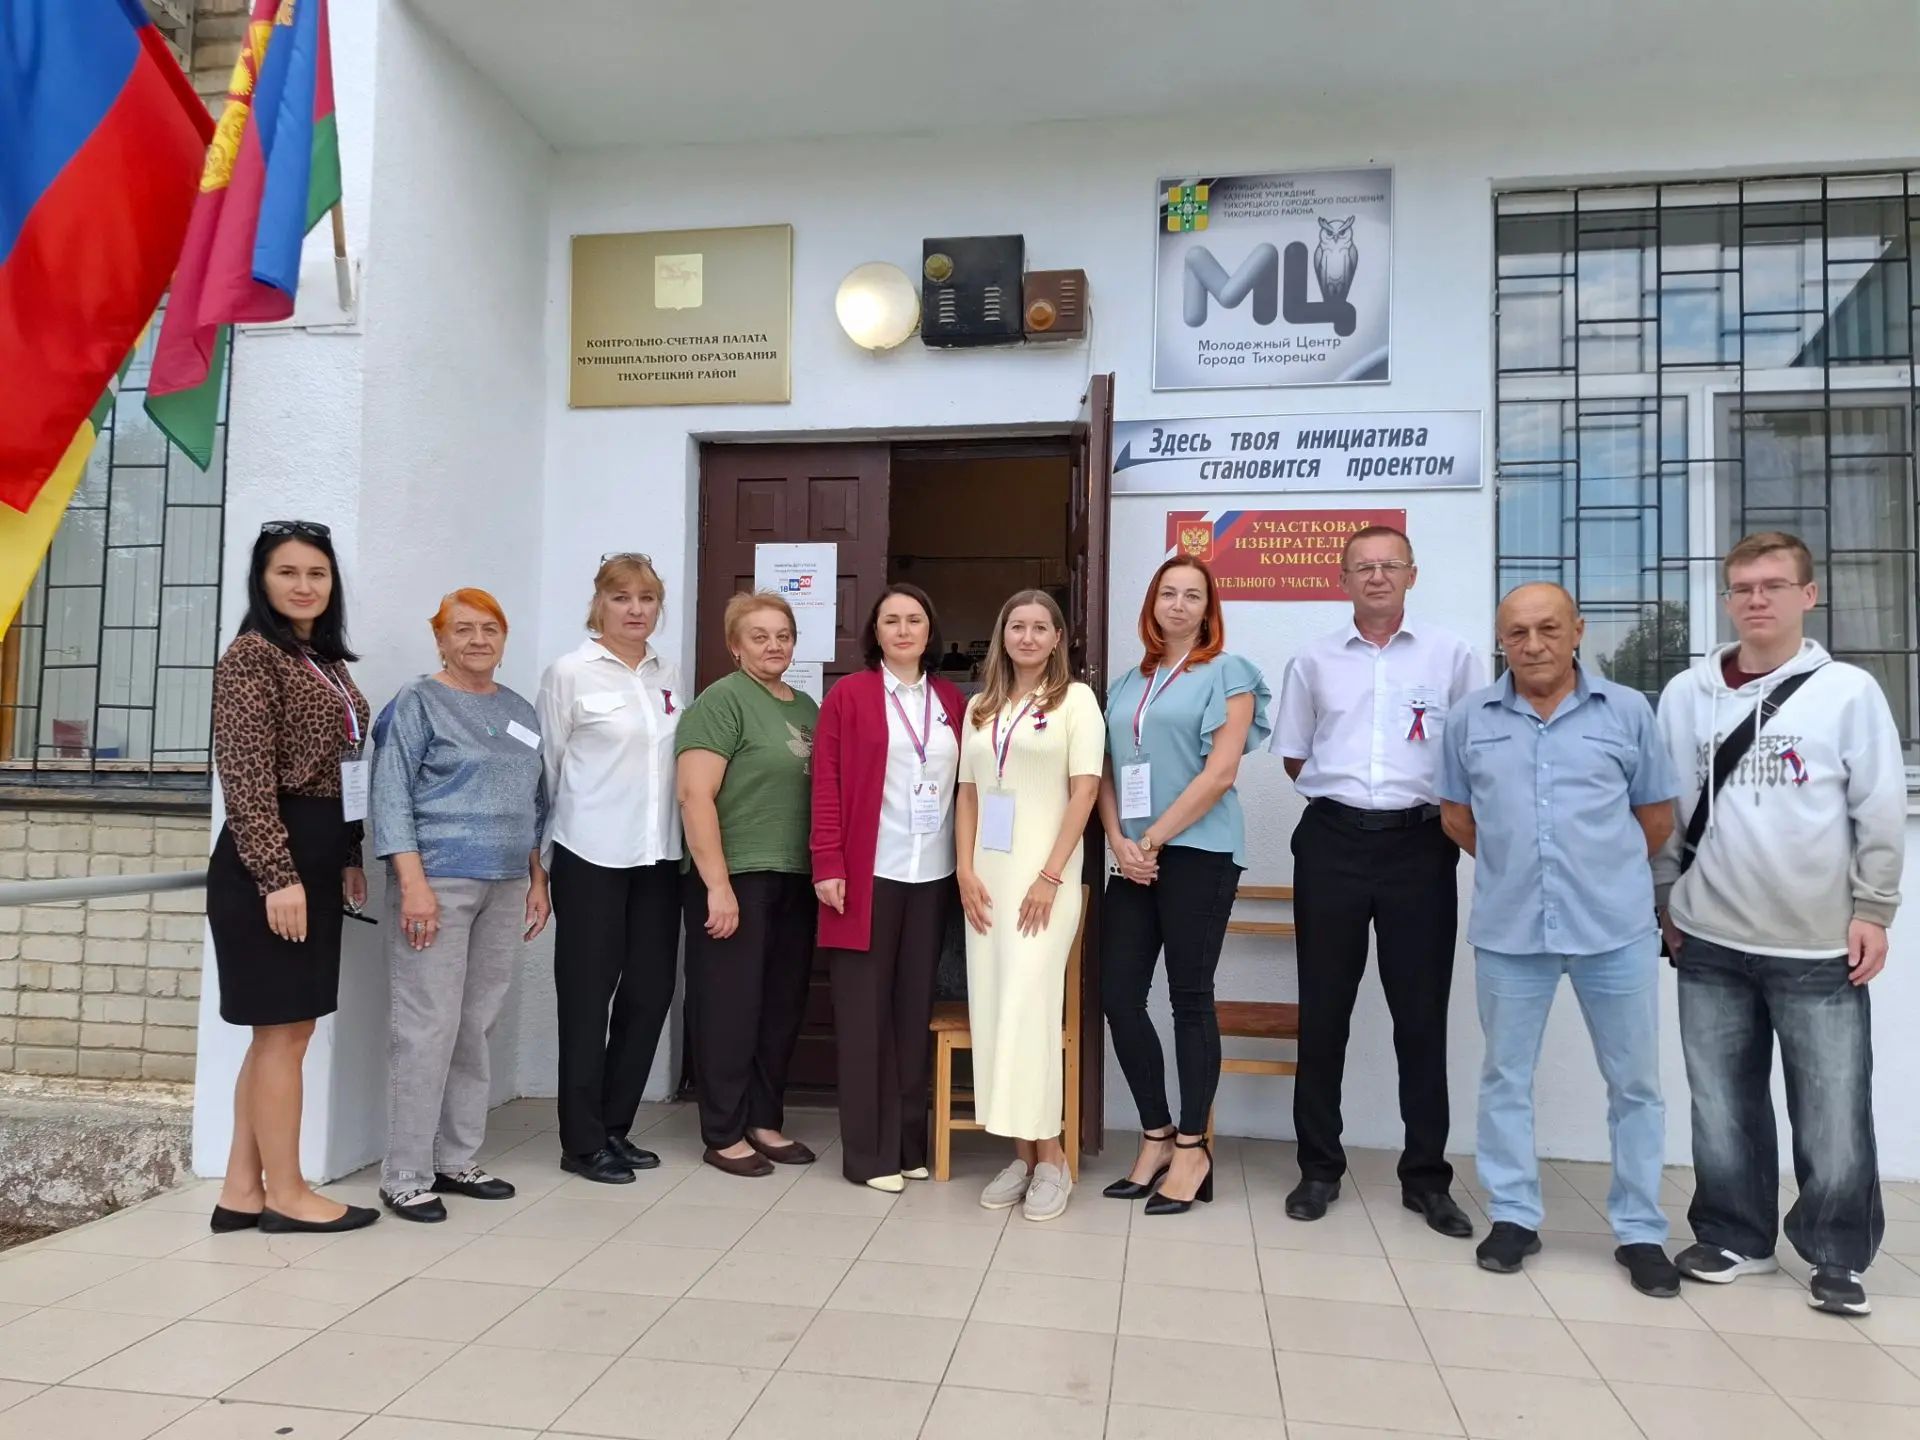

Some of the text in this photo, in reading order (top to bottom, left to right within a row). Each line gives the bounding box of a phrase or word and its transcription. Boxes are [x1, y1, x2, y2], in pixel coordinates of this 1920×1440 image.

[1224, 182, 1295, 191] МУНИЦИПАЛЬНОЕ
[1224, 189, 1316, 200] КАЗЕННОЕ УЧРЕЖДЕНИЕ
[1224, 194, 1384, 210] ТИХОРЕЦКОГО ГОРОДСКОГО ПОСЕЛЕНИЯ
[1224, 208, 1314, 218] ТИХОРЕЦКОГО РАЙОНА
[1183, 241, 1357, 337] МЦ
[587, 333, 768, 348] КОНТРОЛЬНО-СЧЕТНАЯ ПАЛАТА
[1199, 336, 1342, 352] Молодежный Центр
[578, 351, 777, 366] МУНИЦИПАЛЬНОГО ОБРАЗОВАНИЯ
[1198, 351, 1326, 368] Города Тихорецка
[617, 369, 737, 382] ТИХОРЕЦКИЙ РАЙОН
[1149, 426, 1428, 457] Здесь твоя инициатива
[1199, 455, 1455, 481] становится проектом
[1253, 520, 1370, 534] УЧАСТКОВАЯ
[1260, 552, 1344, 565] КОМИССИ
[780, 585, 789, 593] 18
[800, 577, 811, 586] 20
[1281, 577, 1330, 588] УЧАСТКА
